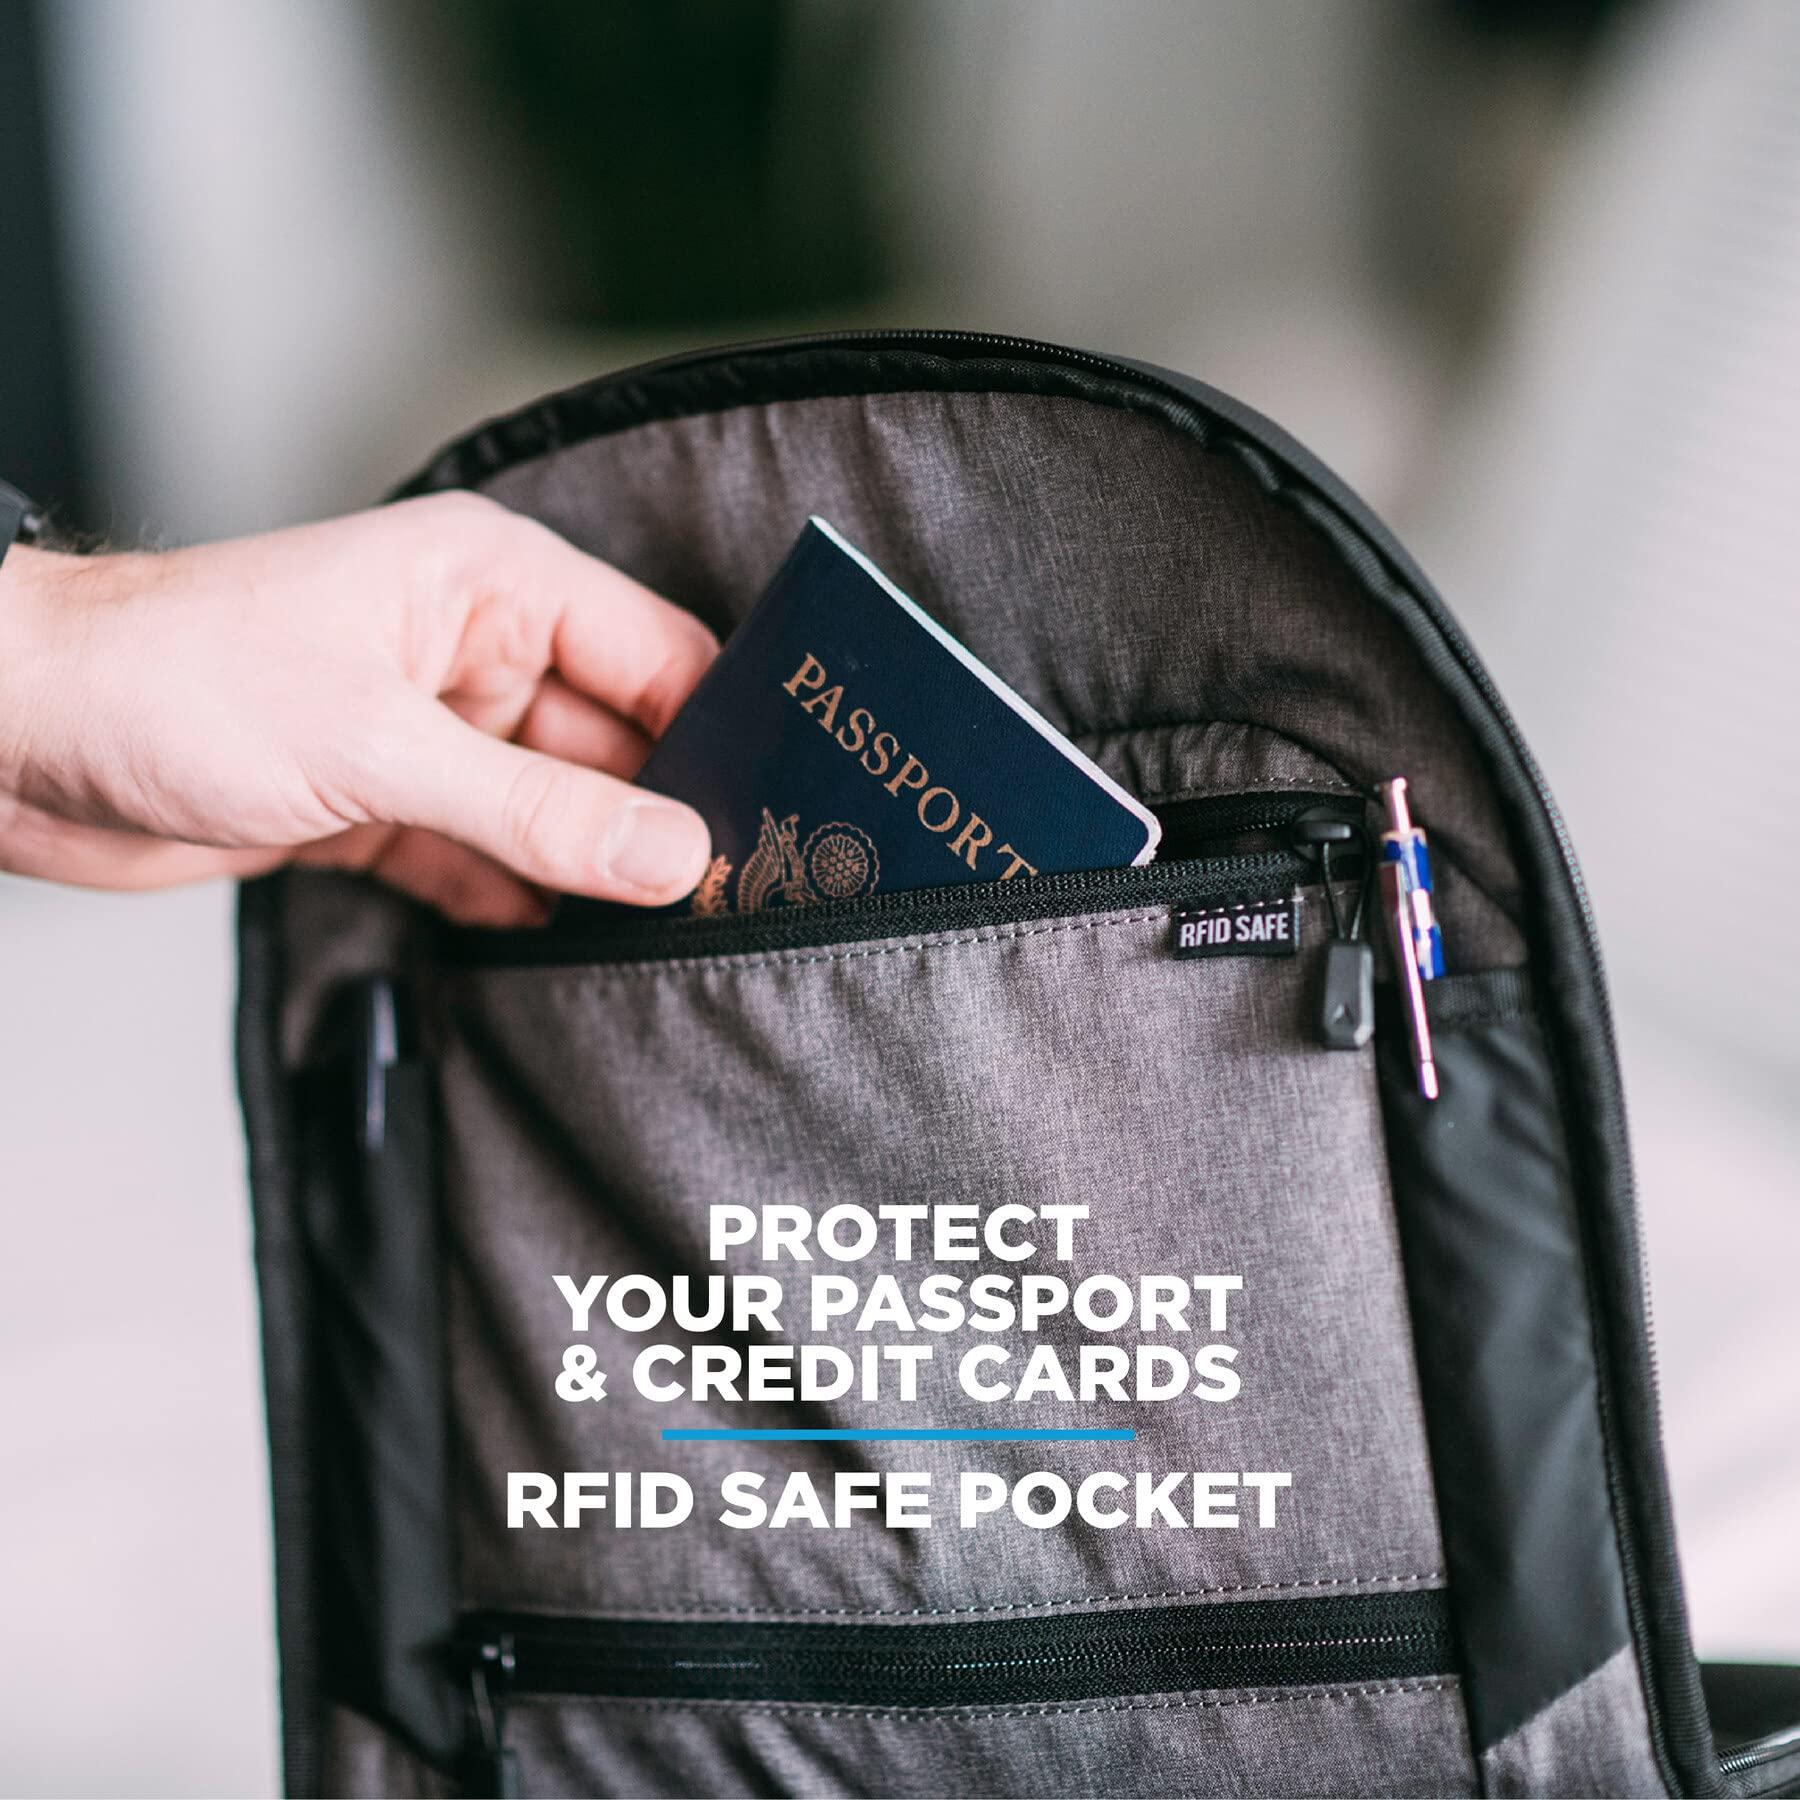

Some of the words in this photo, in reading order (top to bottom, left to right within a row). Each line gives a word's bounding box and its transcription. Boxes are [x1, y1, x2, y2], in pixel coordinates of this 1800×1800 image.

[782, 652, 1038, 881] PASSPORT
[1179, 918, 1232, 948] RFID
[1235, 912, 1289, 942] SAFE
